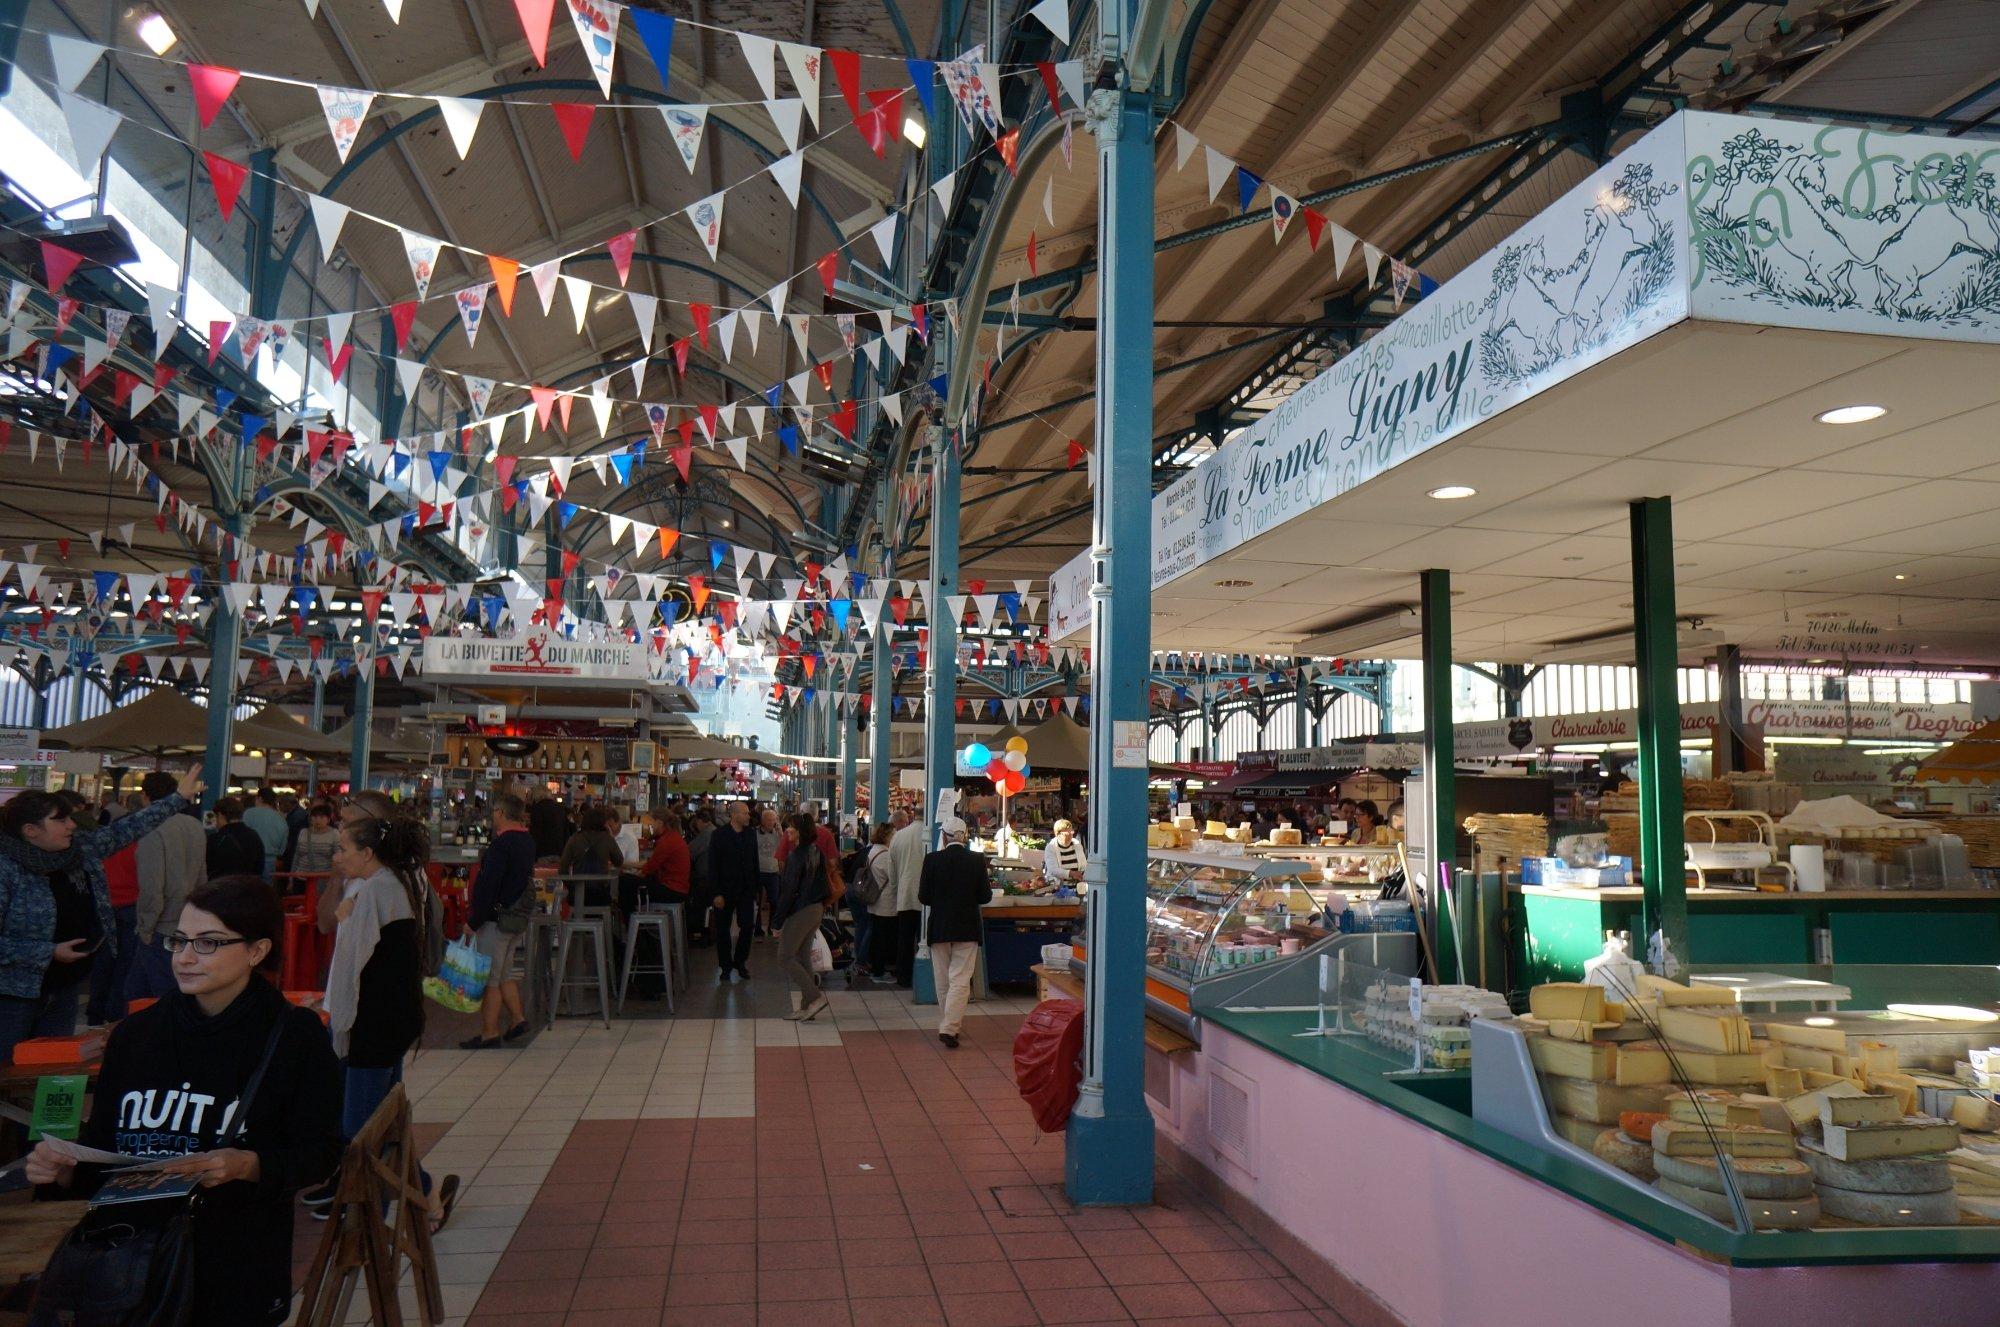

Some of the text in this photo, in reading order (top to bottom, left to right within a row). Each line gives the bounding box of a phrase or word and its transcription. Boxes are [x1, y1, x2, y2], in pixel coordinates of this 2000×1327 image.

[1687, 155, 1793, 293] La
[1319, 369, 1332, 396] et
[1334, 340, 1395, 388] vaches
[1199, 338, 1475, 530] La Ferme Ligny
[1233, 488, 1289, 543] Viande
[1295, 467, 1312, 503] et
[442, 643, 630, 665] LA BUVETTE DU MARCHÉ
[1552, 717, 1626, 738] Charcuterie
[46, 1093, 74, 1107] BIEN
